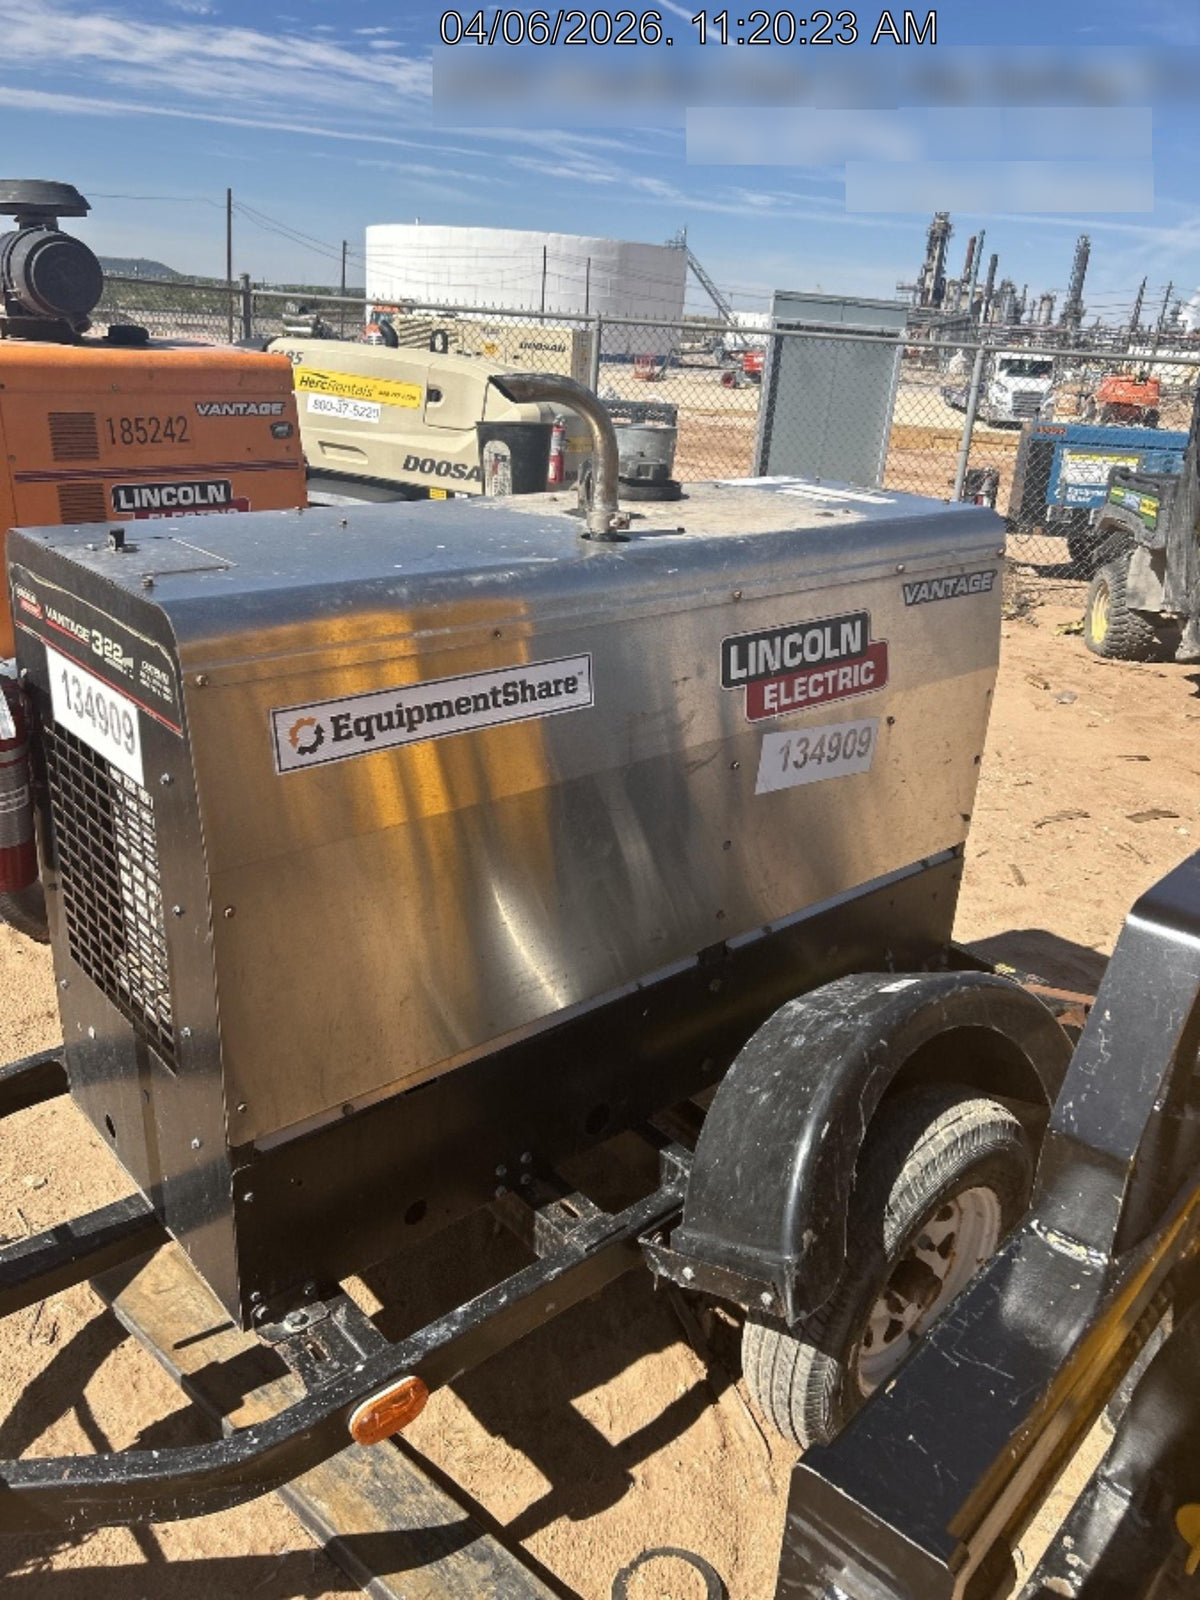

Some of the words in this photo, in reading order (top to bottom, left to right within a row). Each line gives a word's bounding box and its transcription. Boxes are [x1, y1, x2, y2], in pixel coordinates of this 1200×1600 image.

[196, 402, 284, 417] VANTAGE
[106, 415, 191, 446] 185242
[402, 454, 483, 483] DOOSA
[118, 484, 226, 510] LINCOLN
[903, 571, 995, 605] VANTAGE
[91, 629, 123, 661] 322
[729, 619, 862, 681] LINCOLN
[763, 660, 876, 711] ELECTRIC
[62, 668, 136, 756] 134909
[330, 674, 580, 742] EquipmentShare
[779, 725, 873, 773] 134909
